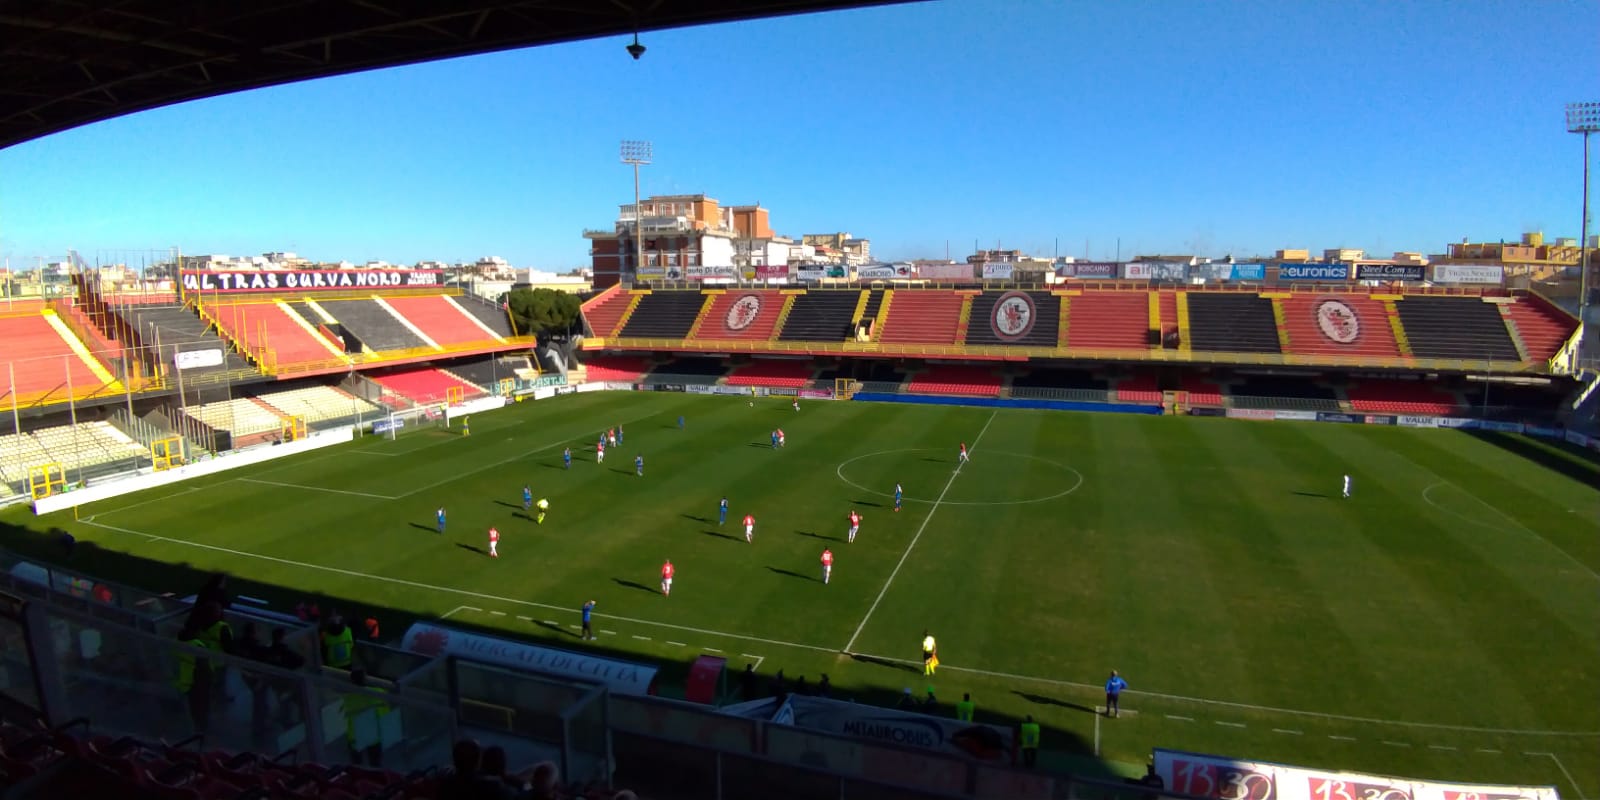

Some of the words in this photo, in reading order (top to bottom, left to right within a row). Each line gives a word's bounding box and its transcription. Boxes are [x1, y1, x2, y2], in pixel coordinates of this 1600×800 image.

[1287, 265, 1346, 278] euronics
[1361, 265, 1382, 273] Steel
[184, 272, 278, 290] ULTRAS
[285, 271, 352, 288] CURVA
[356, 270, 401, 286] NORD
[843, 719, 934, 746] METAUROBUS
